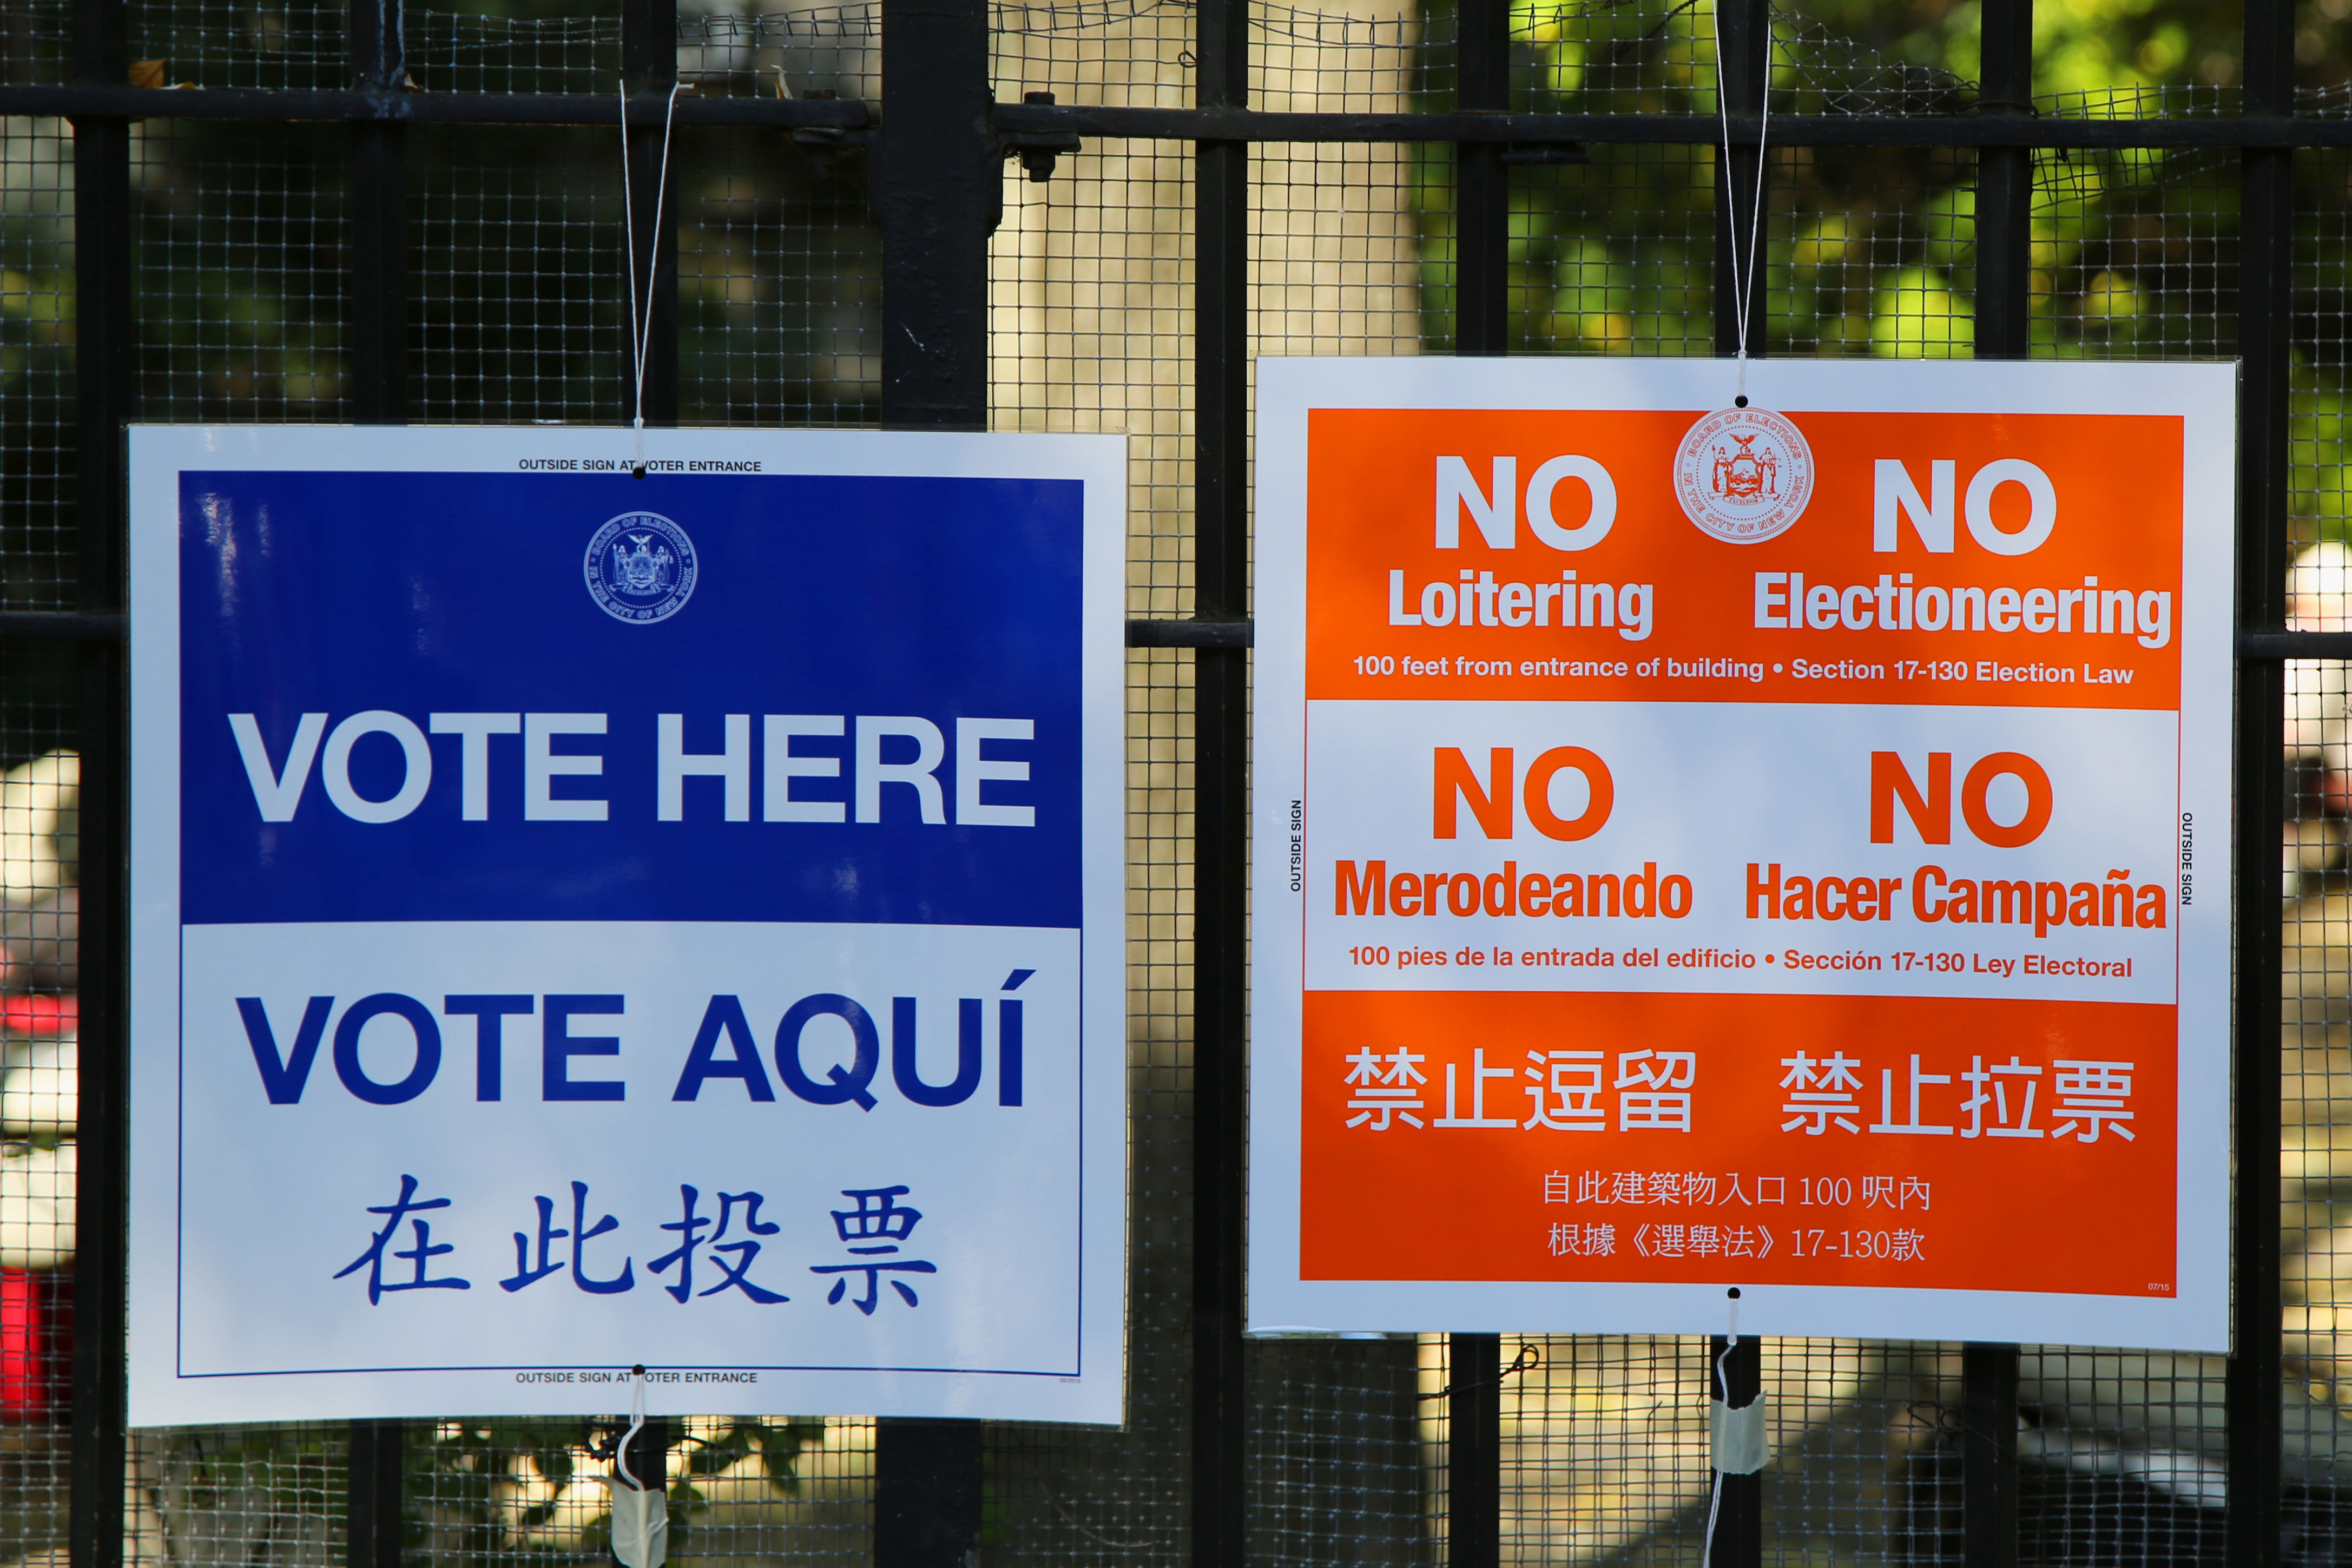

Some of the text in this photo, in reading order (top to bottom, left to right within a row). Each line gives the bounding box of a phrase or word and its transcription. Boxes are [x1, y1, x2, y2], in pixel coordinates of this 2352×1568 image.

[519, 459, 577, 470] OUTSIDE
[583, 459, 615, 471] SIGN
[620, 460, 636, 470] AT
[689, 460, 761, 472] ENTRANCE
[1688, 413, 1802, 460] BOARD OF ELECTIONS
[591, 516, 690, 556] BOARD OF ELECTIONS
[1435, 455, 1617, 552] NO
[1684, 473, 1804, 533] IN THE CITY OF NEW YORK
[1874, 459, 2057, 556] NO
[589, 566, 693, 619] IN THE CITY OF NEW YORK
[1389, 569, 1653, 641] Loitering
[1755, 572, 2171, 649] Electioneering
[1354, 655, 2134, 684] 100 feet from entrance of building Section 17-130 Election Law
[228, 710, 1036, 827] VOTE HERE
[1434, 747, 1614, 842] NO
[1871, 752, 2053, 848] NO
[1291, 800, 1301, 892] OUTSIDE SIGN
[2182, 813, 2192, 905] OUTSIDE SIGN
[1336, 861, 1692, 919] Merodeando
[1747, 864, 2166, 938] Hacer Campaña
[1349, 946, 2132, 978] 100 pies de la entrada del edificio Sección 17-130 Ley Electoral
[236, 969, 1037, 1112] VOTE AQUÍ
[1344, 1046, 1696, 1133] 禁止逗留
[1779, 1050, 2136, 1143] 禁止拉票
[1544, 1170, 1785, 1206] 自此建築物入口
[1800, 1177, 1852, 1206] 100
[333, 1174, 937, 1315] 在此投票
[2148, 1283, 2170, 1291] 07/15
[516, 1372, 756, 1383] OUTSIDE SIGN AT OTER ENTRANCE
